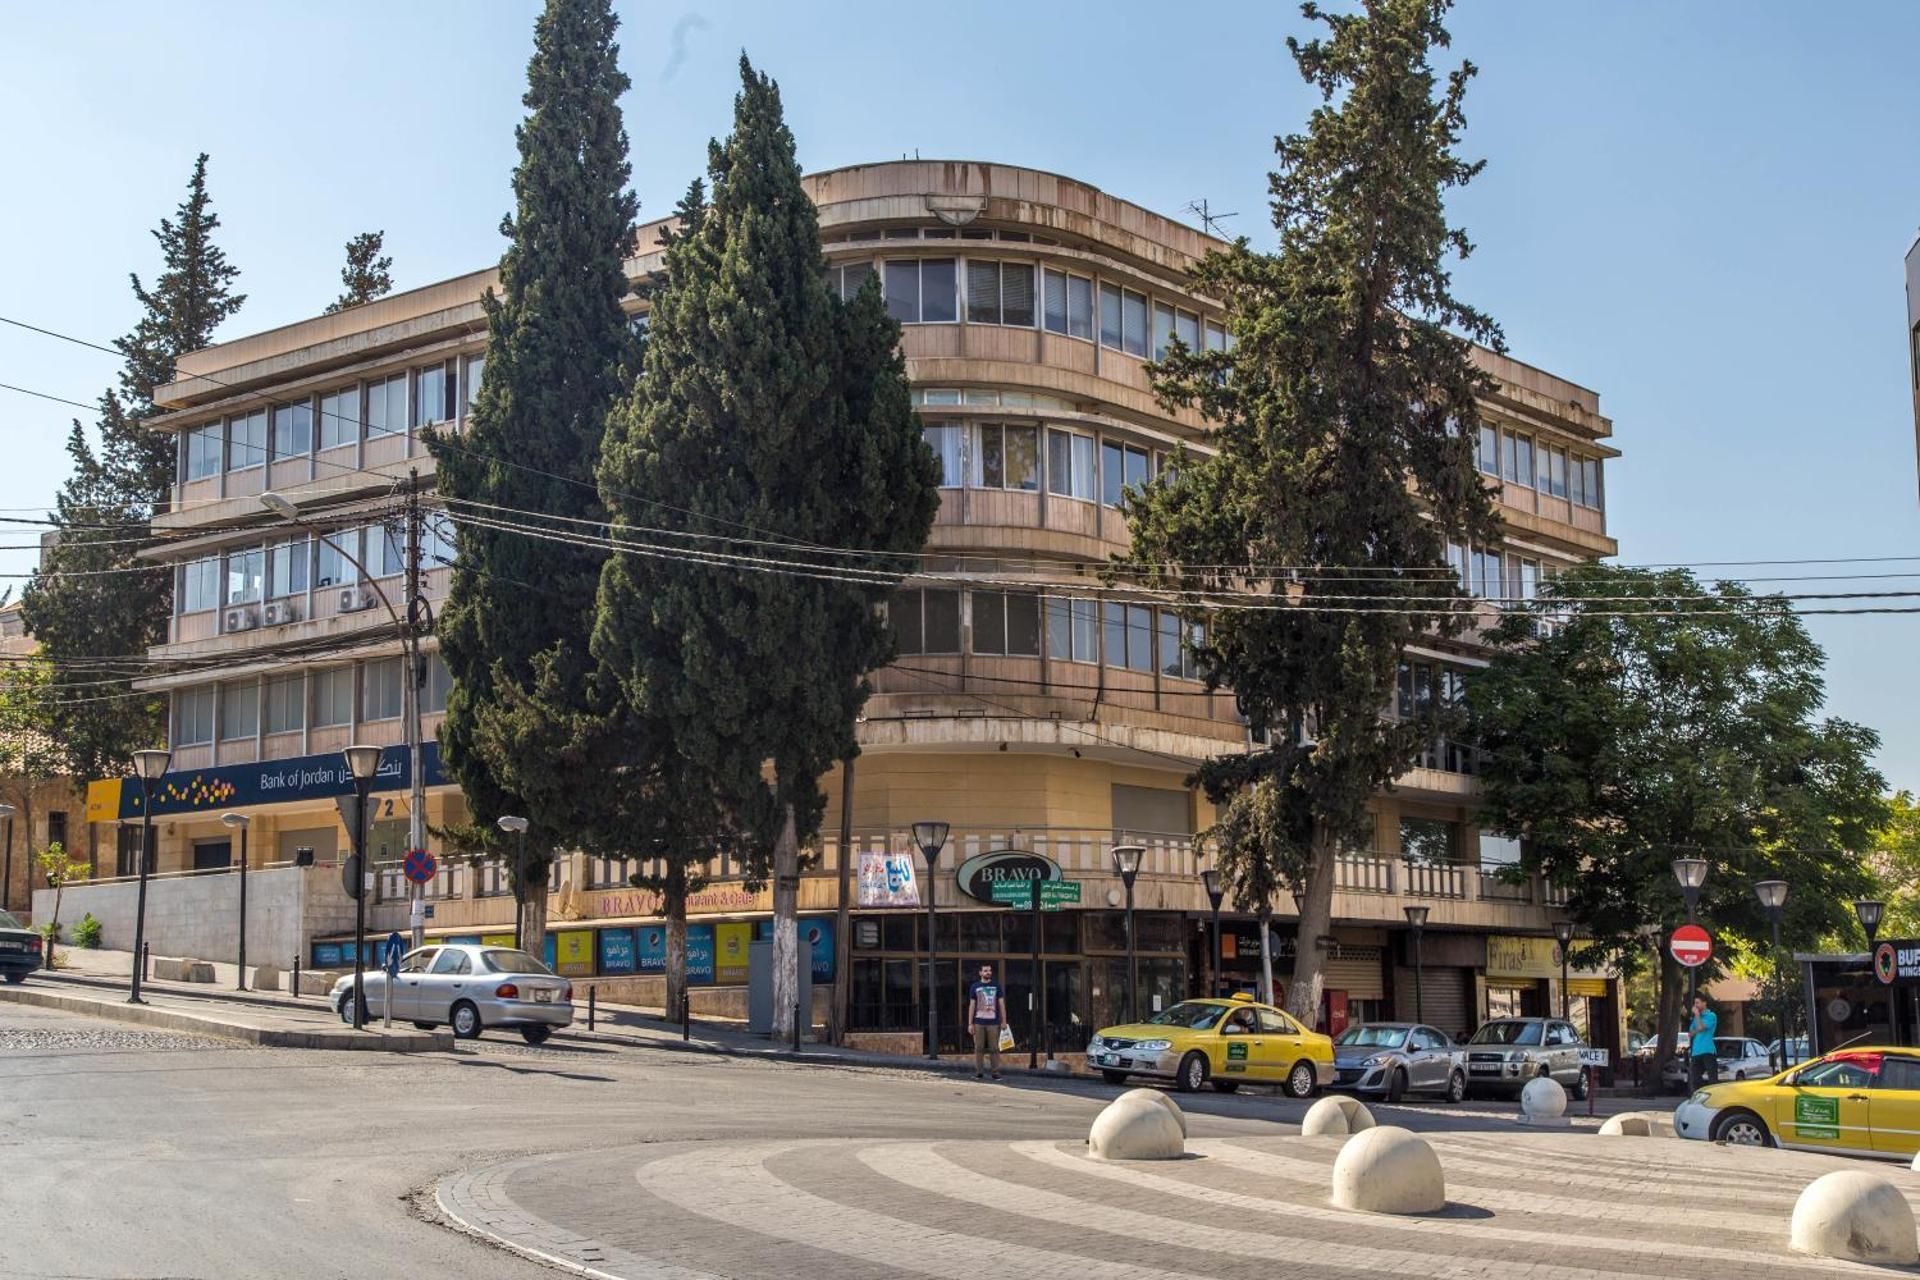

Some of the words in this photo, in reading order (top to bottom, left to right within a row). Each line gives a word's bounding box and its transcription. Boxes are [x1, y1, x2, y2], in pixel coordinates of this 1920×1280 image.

[260, 771, 285, 790] Bank
[287, 772, 298, 786] of
[300, 767, 334, 790] Jordan
[384, 799, 394, 817] 2
[981, 867, 1042, 882] BRAVO
[601, 893, 657, 914] BRAVO
[606, 960, 631, 969] BRAVO
[1489, 942, 1523, 970] Firas
[1897, 948, 1920, 966] BUF
[1898, 966, 1920, 977] WING
